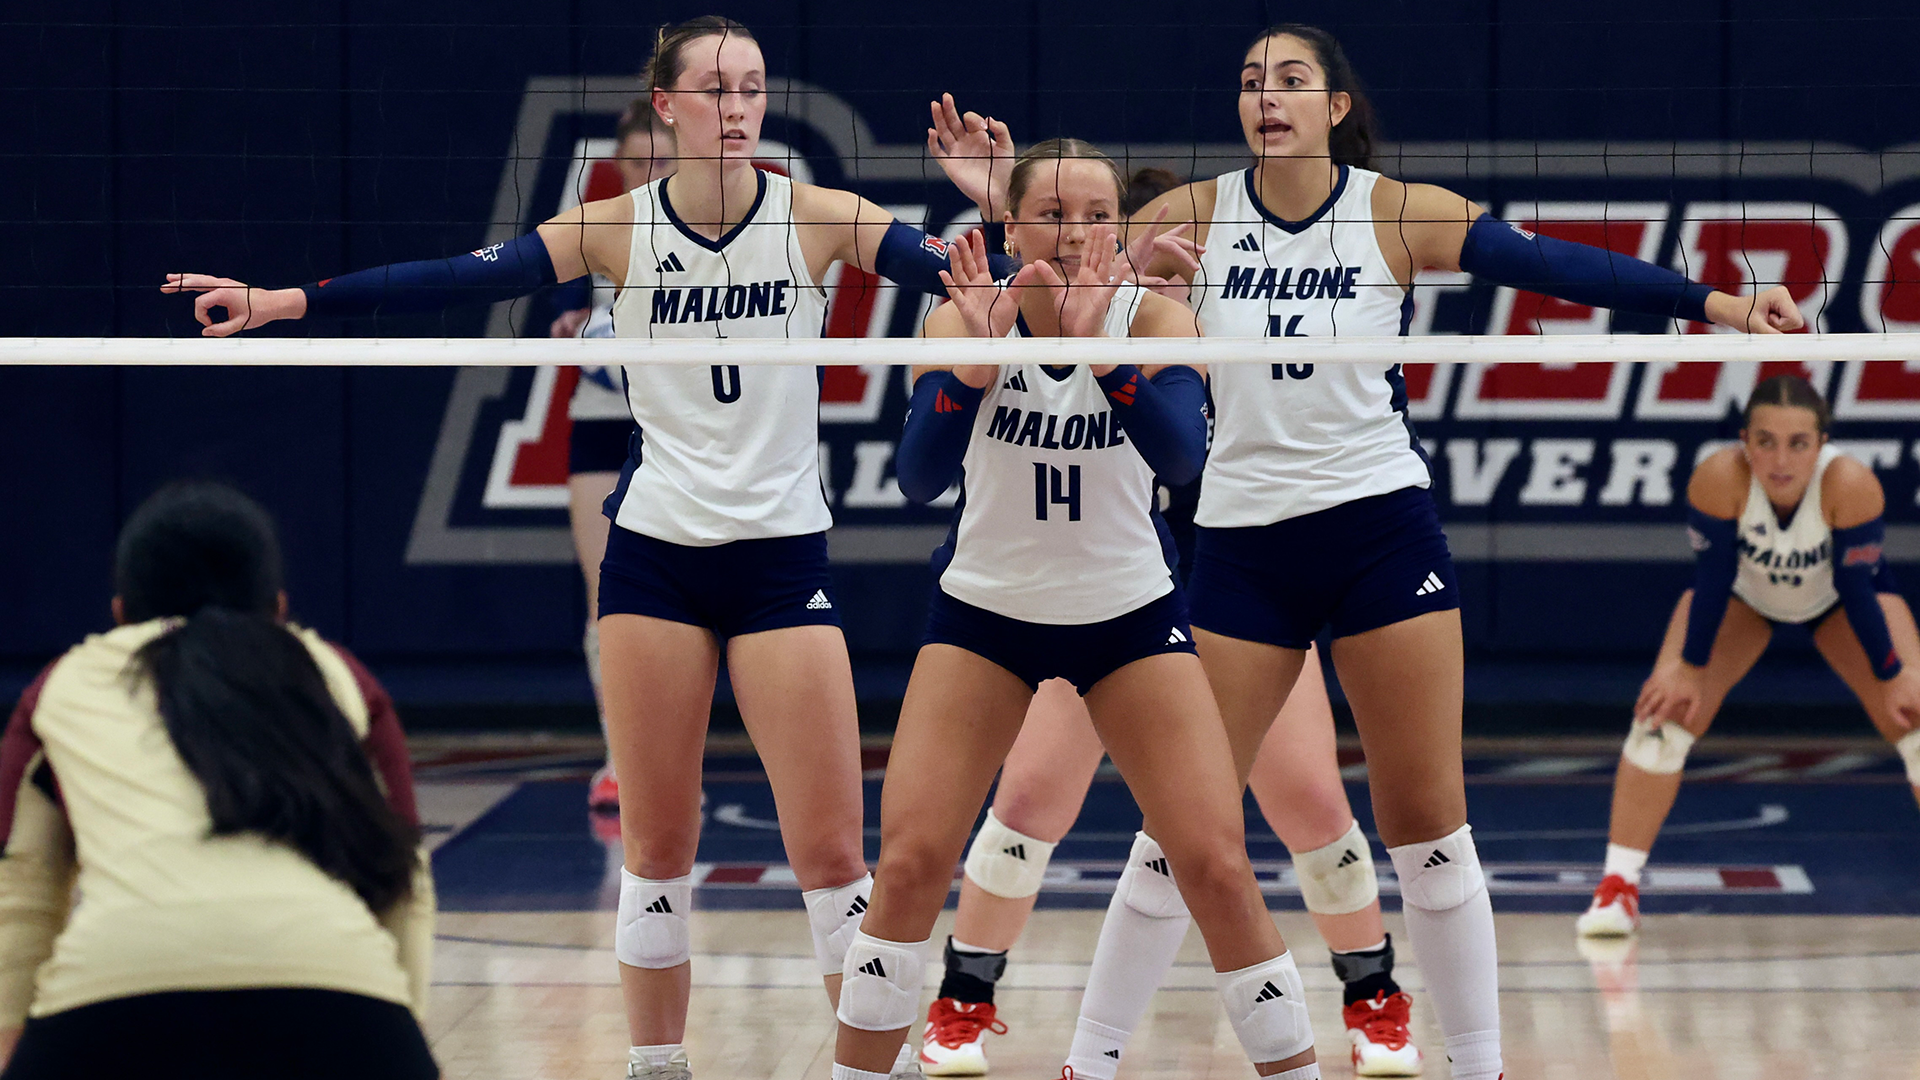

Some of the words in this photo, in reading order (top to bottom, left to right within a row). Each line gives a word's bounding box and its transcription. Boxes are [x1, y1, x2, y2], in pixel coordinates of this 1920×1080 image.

[650, 279, 790, 324] MALONE
[1220, 265, 1362, 300] MALONE
[986, 405, 1125, 450] MALONE
[1032, 462, 1081, 521] 14
